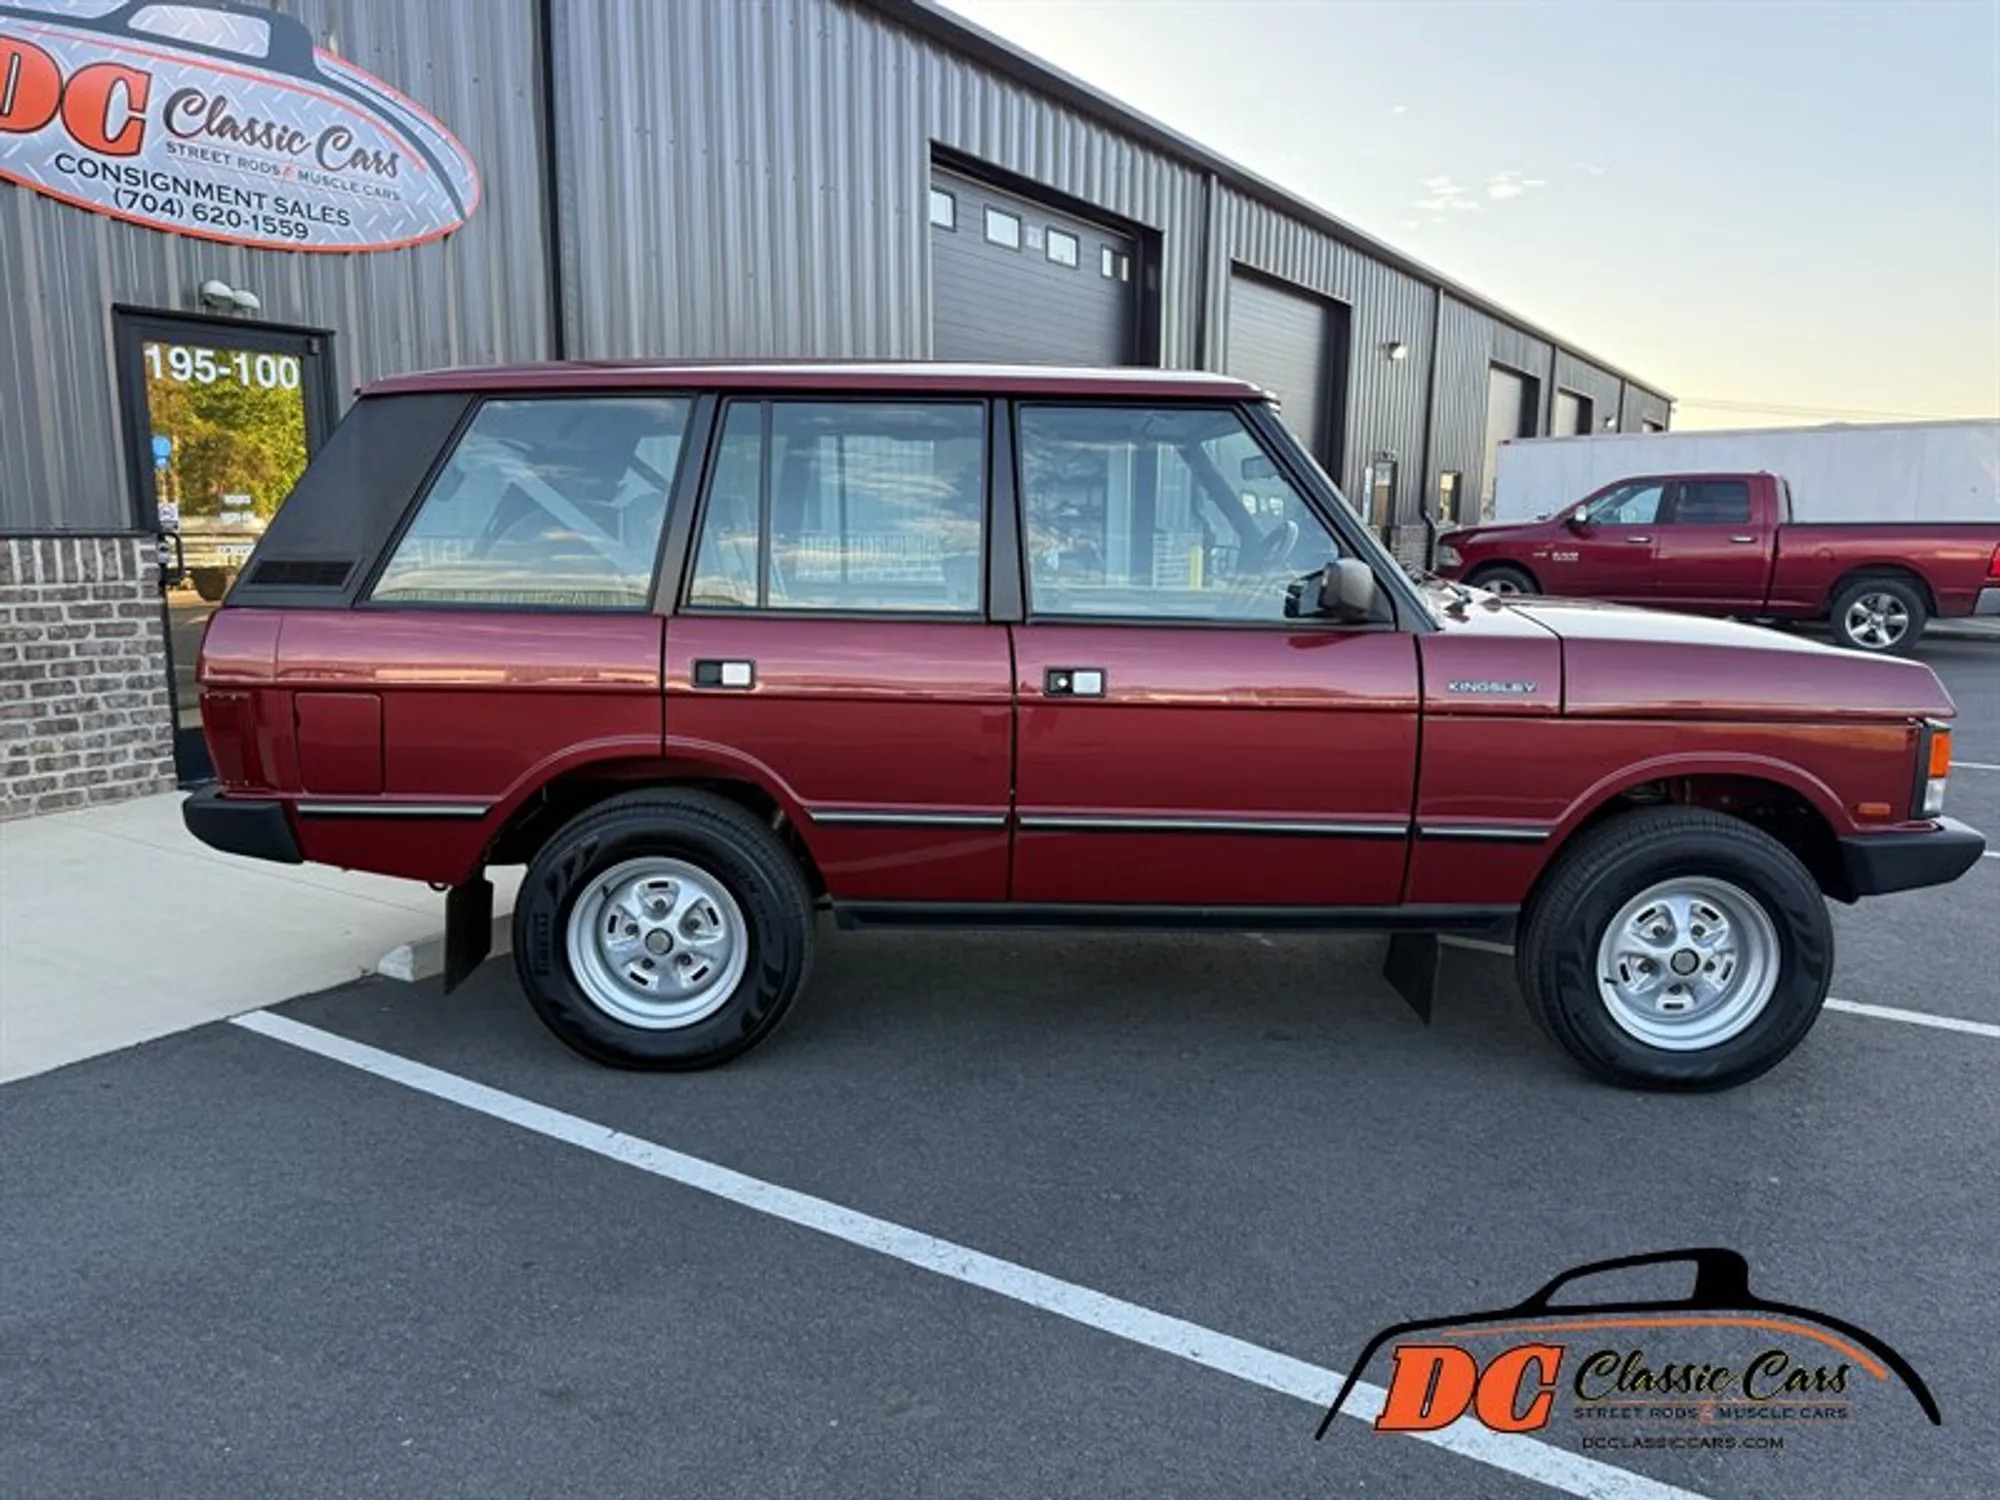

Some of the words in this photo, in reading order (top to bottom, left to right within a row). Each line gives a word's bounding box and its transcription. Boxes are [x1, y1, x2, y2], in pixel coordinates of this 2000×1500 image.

[0, 34, 152, 157] DC
[163, 87, 311, 155] Classic
[315, 125, 399, 178] Cars
[54, 152, 268, 211] CONSIGNMENT
[274, 196, 351, 227] SALES
[166, 141, 231, 166] STREET
[237, 158, 280, 177] RODS
[298, 170, 359, 195] MUSCLE
[363, 185, 401, 201] CARS
[113, 187, 184, 219] (704)
[192, 202, 309, 240] 620-1559
[144, 343, 301, 389] 195-100
[1447, 681, 1537, 693] KINGSLEY
